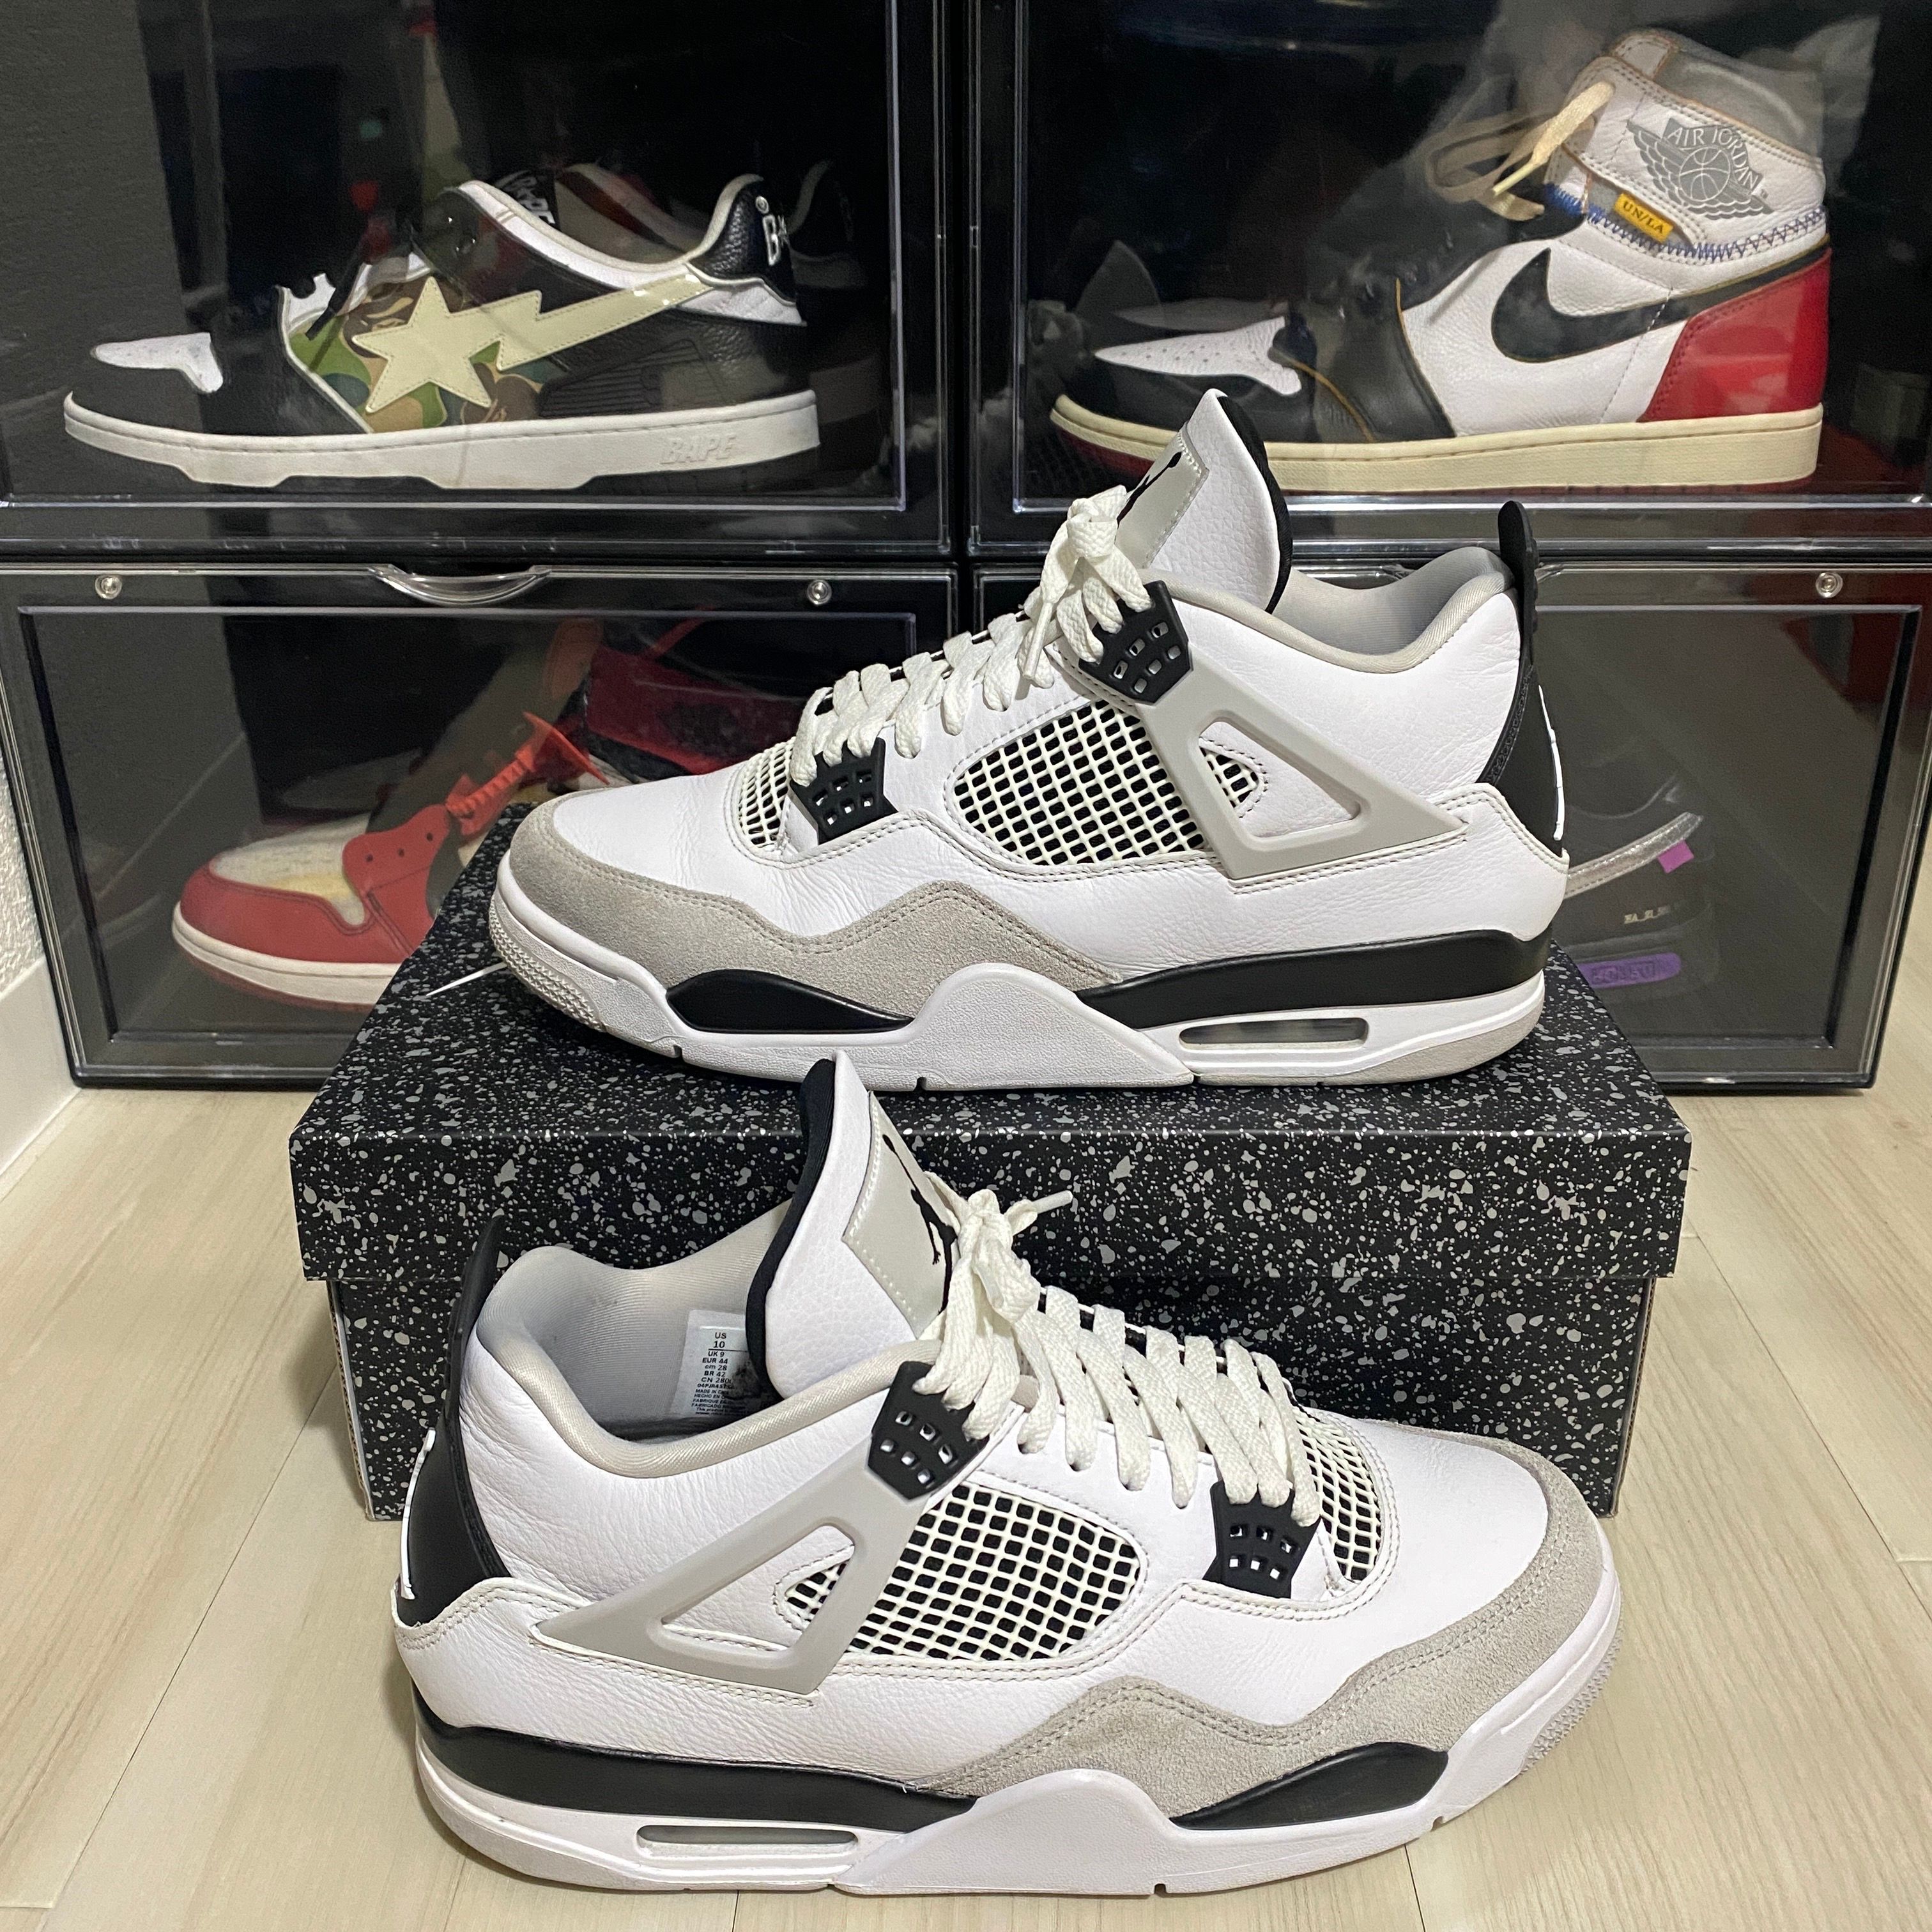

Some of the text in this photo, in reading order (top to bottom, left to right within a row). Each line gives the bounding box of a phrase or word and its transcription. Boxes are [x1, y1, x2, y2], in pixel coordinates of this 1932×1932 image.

[1667, 127, 1705, 146] AIR
[1623, 201, 1664, 234] UN/LA
[659, 436, 737, 464] BAPE
